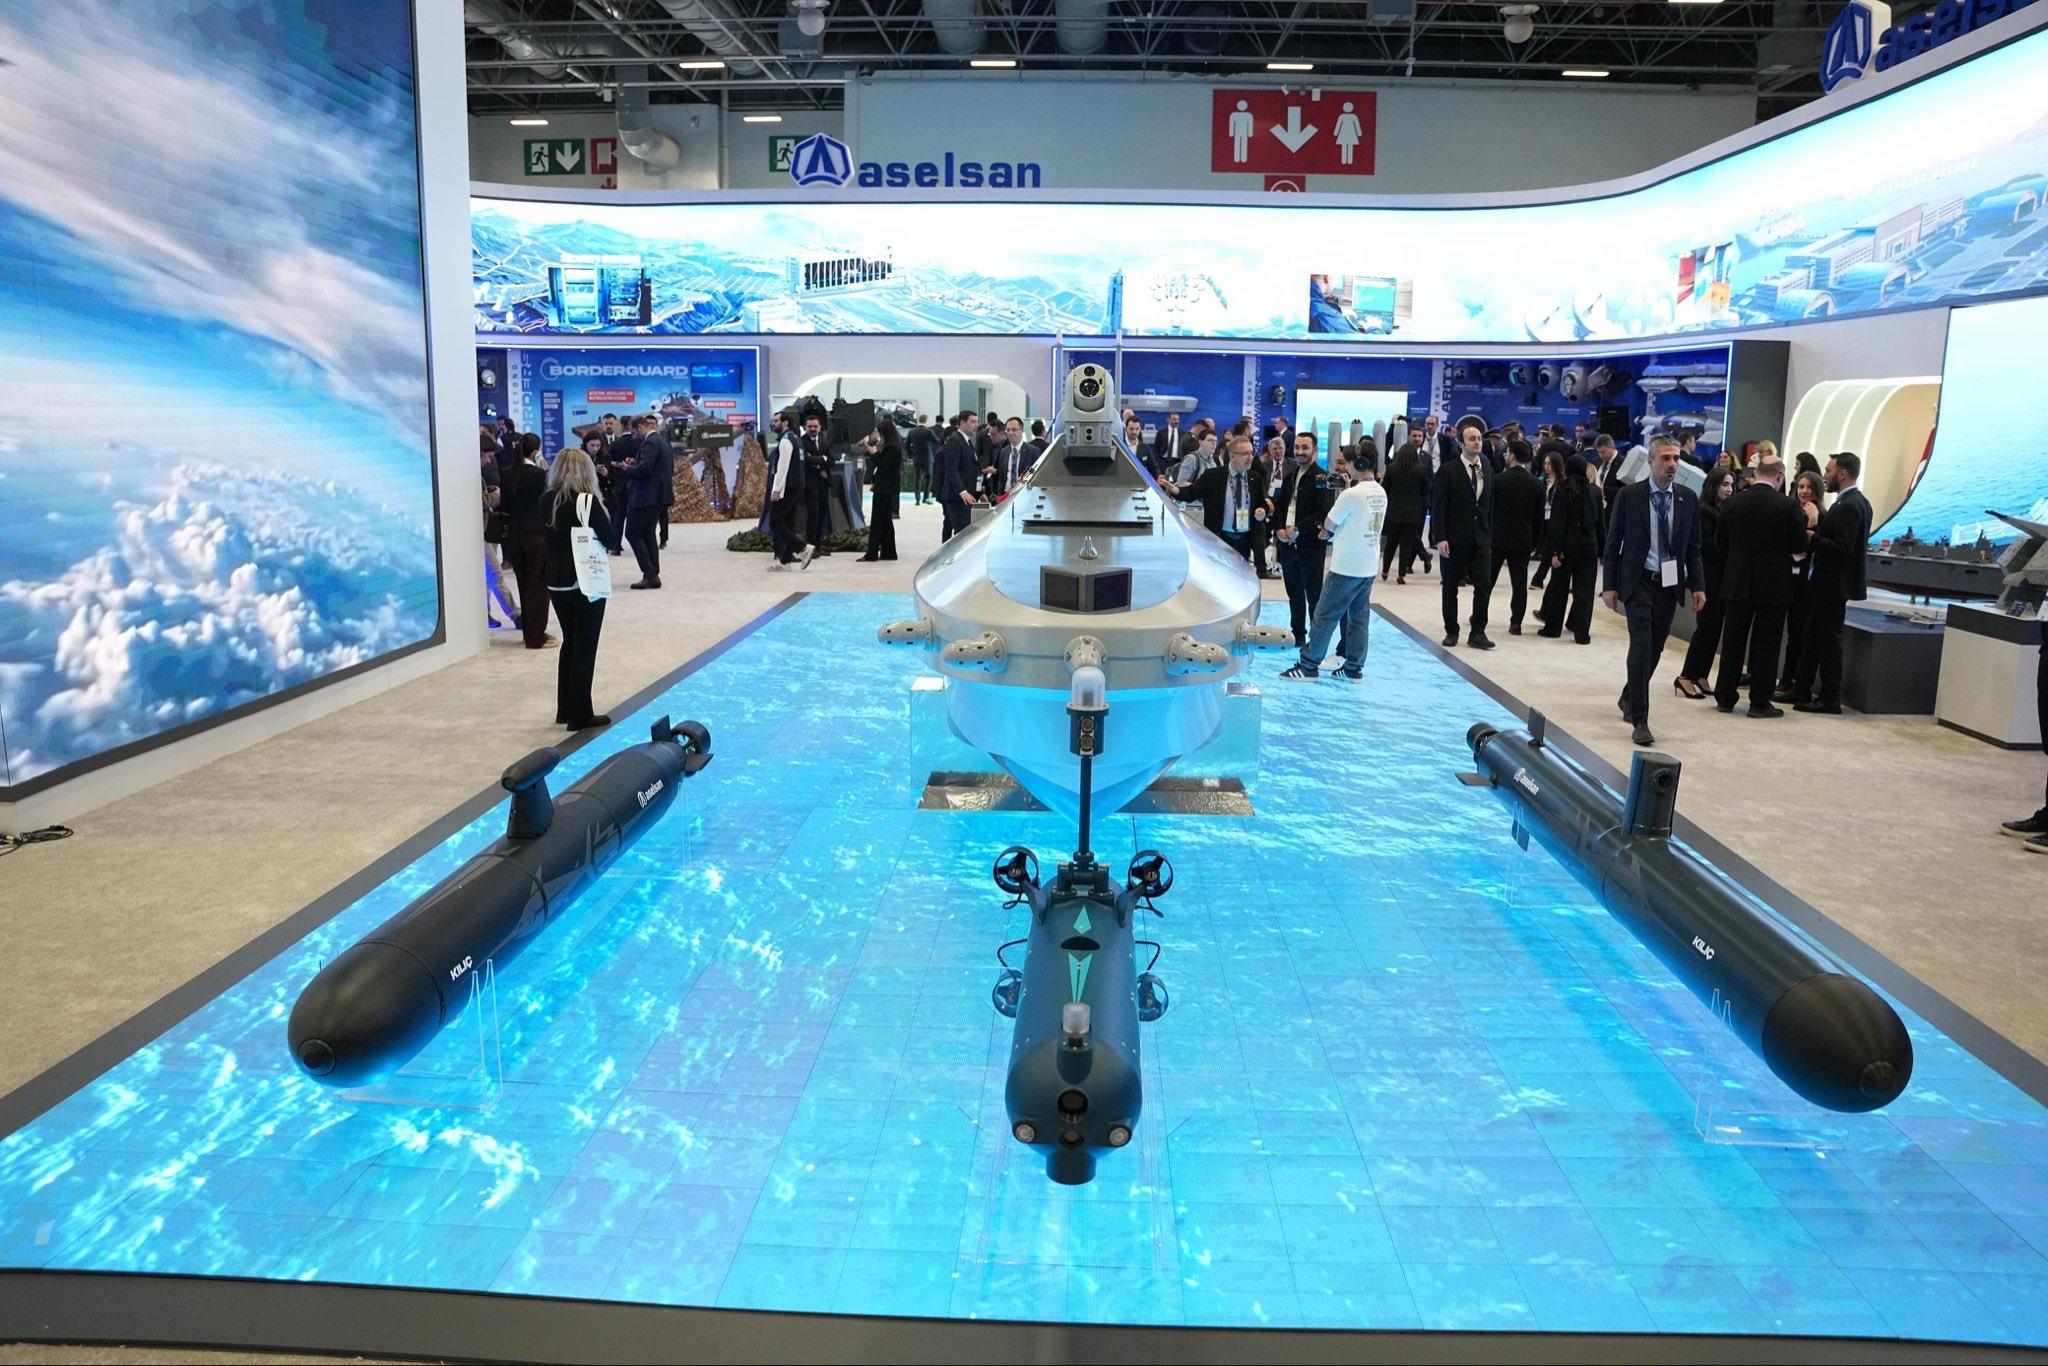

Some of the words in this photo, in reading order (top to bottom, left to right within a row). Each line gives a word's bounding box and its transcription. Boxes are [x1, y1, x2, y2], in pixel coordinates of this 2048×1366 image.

[1875, 0, 2039, 72] asels
[858, 152, 1041, 188] aselsan
[549, 365, 689, 377] BORDERGUARD
[521, 349, 533, 433] ORDERS
[645, 779, 664, 801] aselsan
[1520, 775, 1540, 796] aselsan
[1692, 935, 1715, 961] KILIÇ
